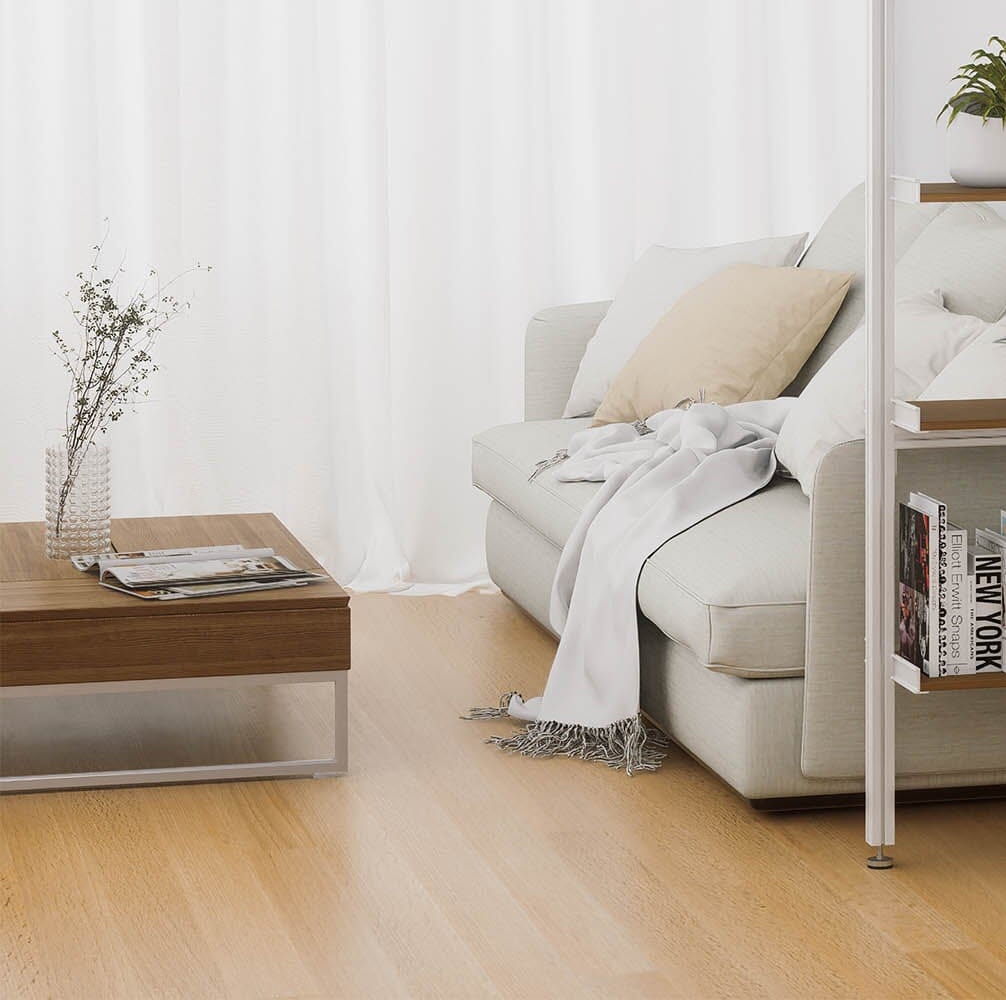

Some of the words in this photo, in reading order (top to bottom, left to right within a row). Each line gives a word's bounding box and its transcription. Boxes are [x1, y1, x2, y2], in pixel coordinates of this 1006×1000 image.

[951, 534, 962, 568] Elliott
[951, 573, 962, 609] Erwitt
[976, 556, 1002, 604] NEW
[949, 614, 963, 658] Snaps
[976, 610, 1002, 671] YORK
